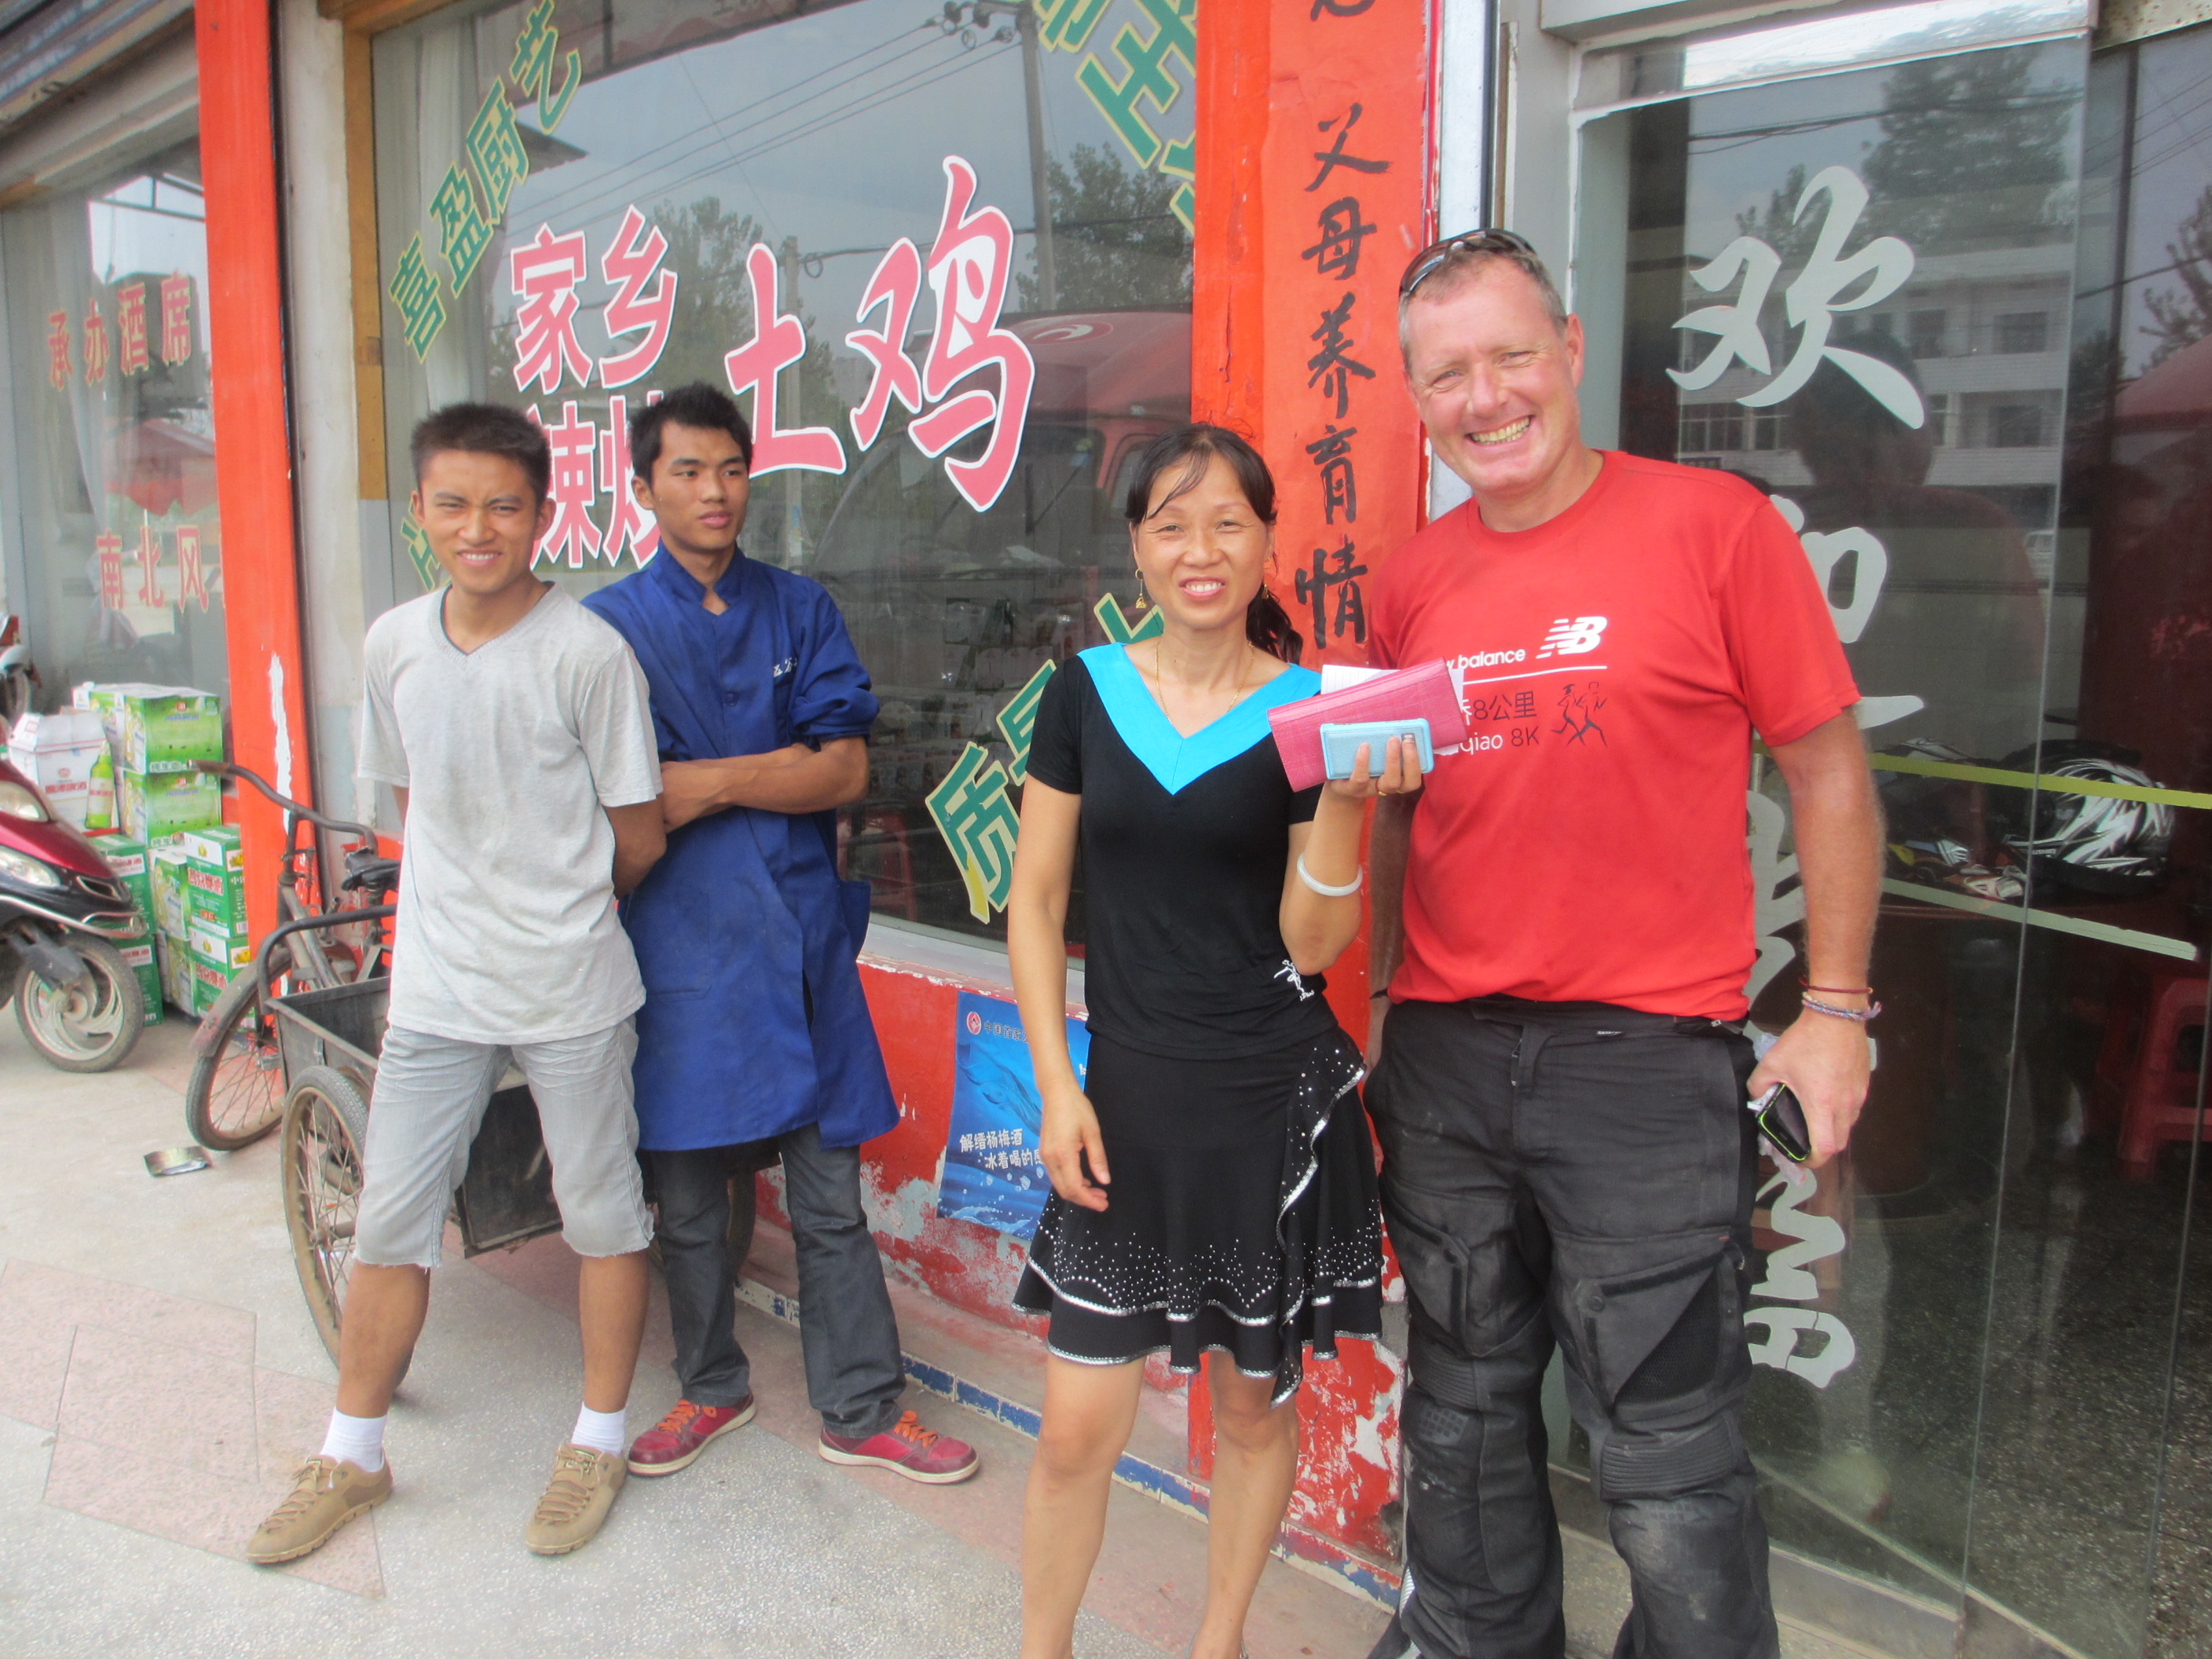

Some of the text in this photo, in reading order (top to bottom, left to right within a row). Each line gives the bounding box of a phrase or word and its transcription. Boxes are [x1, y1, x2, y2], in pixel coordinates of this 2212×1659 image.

[47, 269, 192, 390] 承办酒席
[511, 204, 678, 394] 家乡
[724, 156, 1035, 512] 土鸡
[1295, 0, 1391, 651] 父母养育情
[95, 524, 225, 614] 南北风
[1458, 649, 1526, 669] balance
[1511, 726, 1540, 747] 8K
